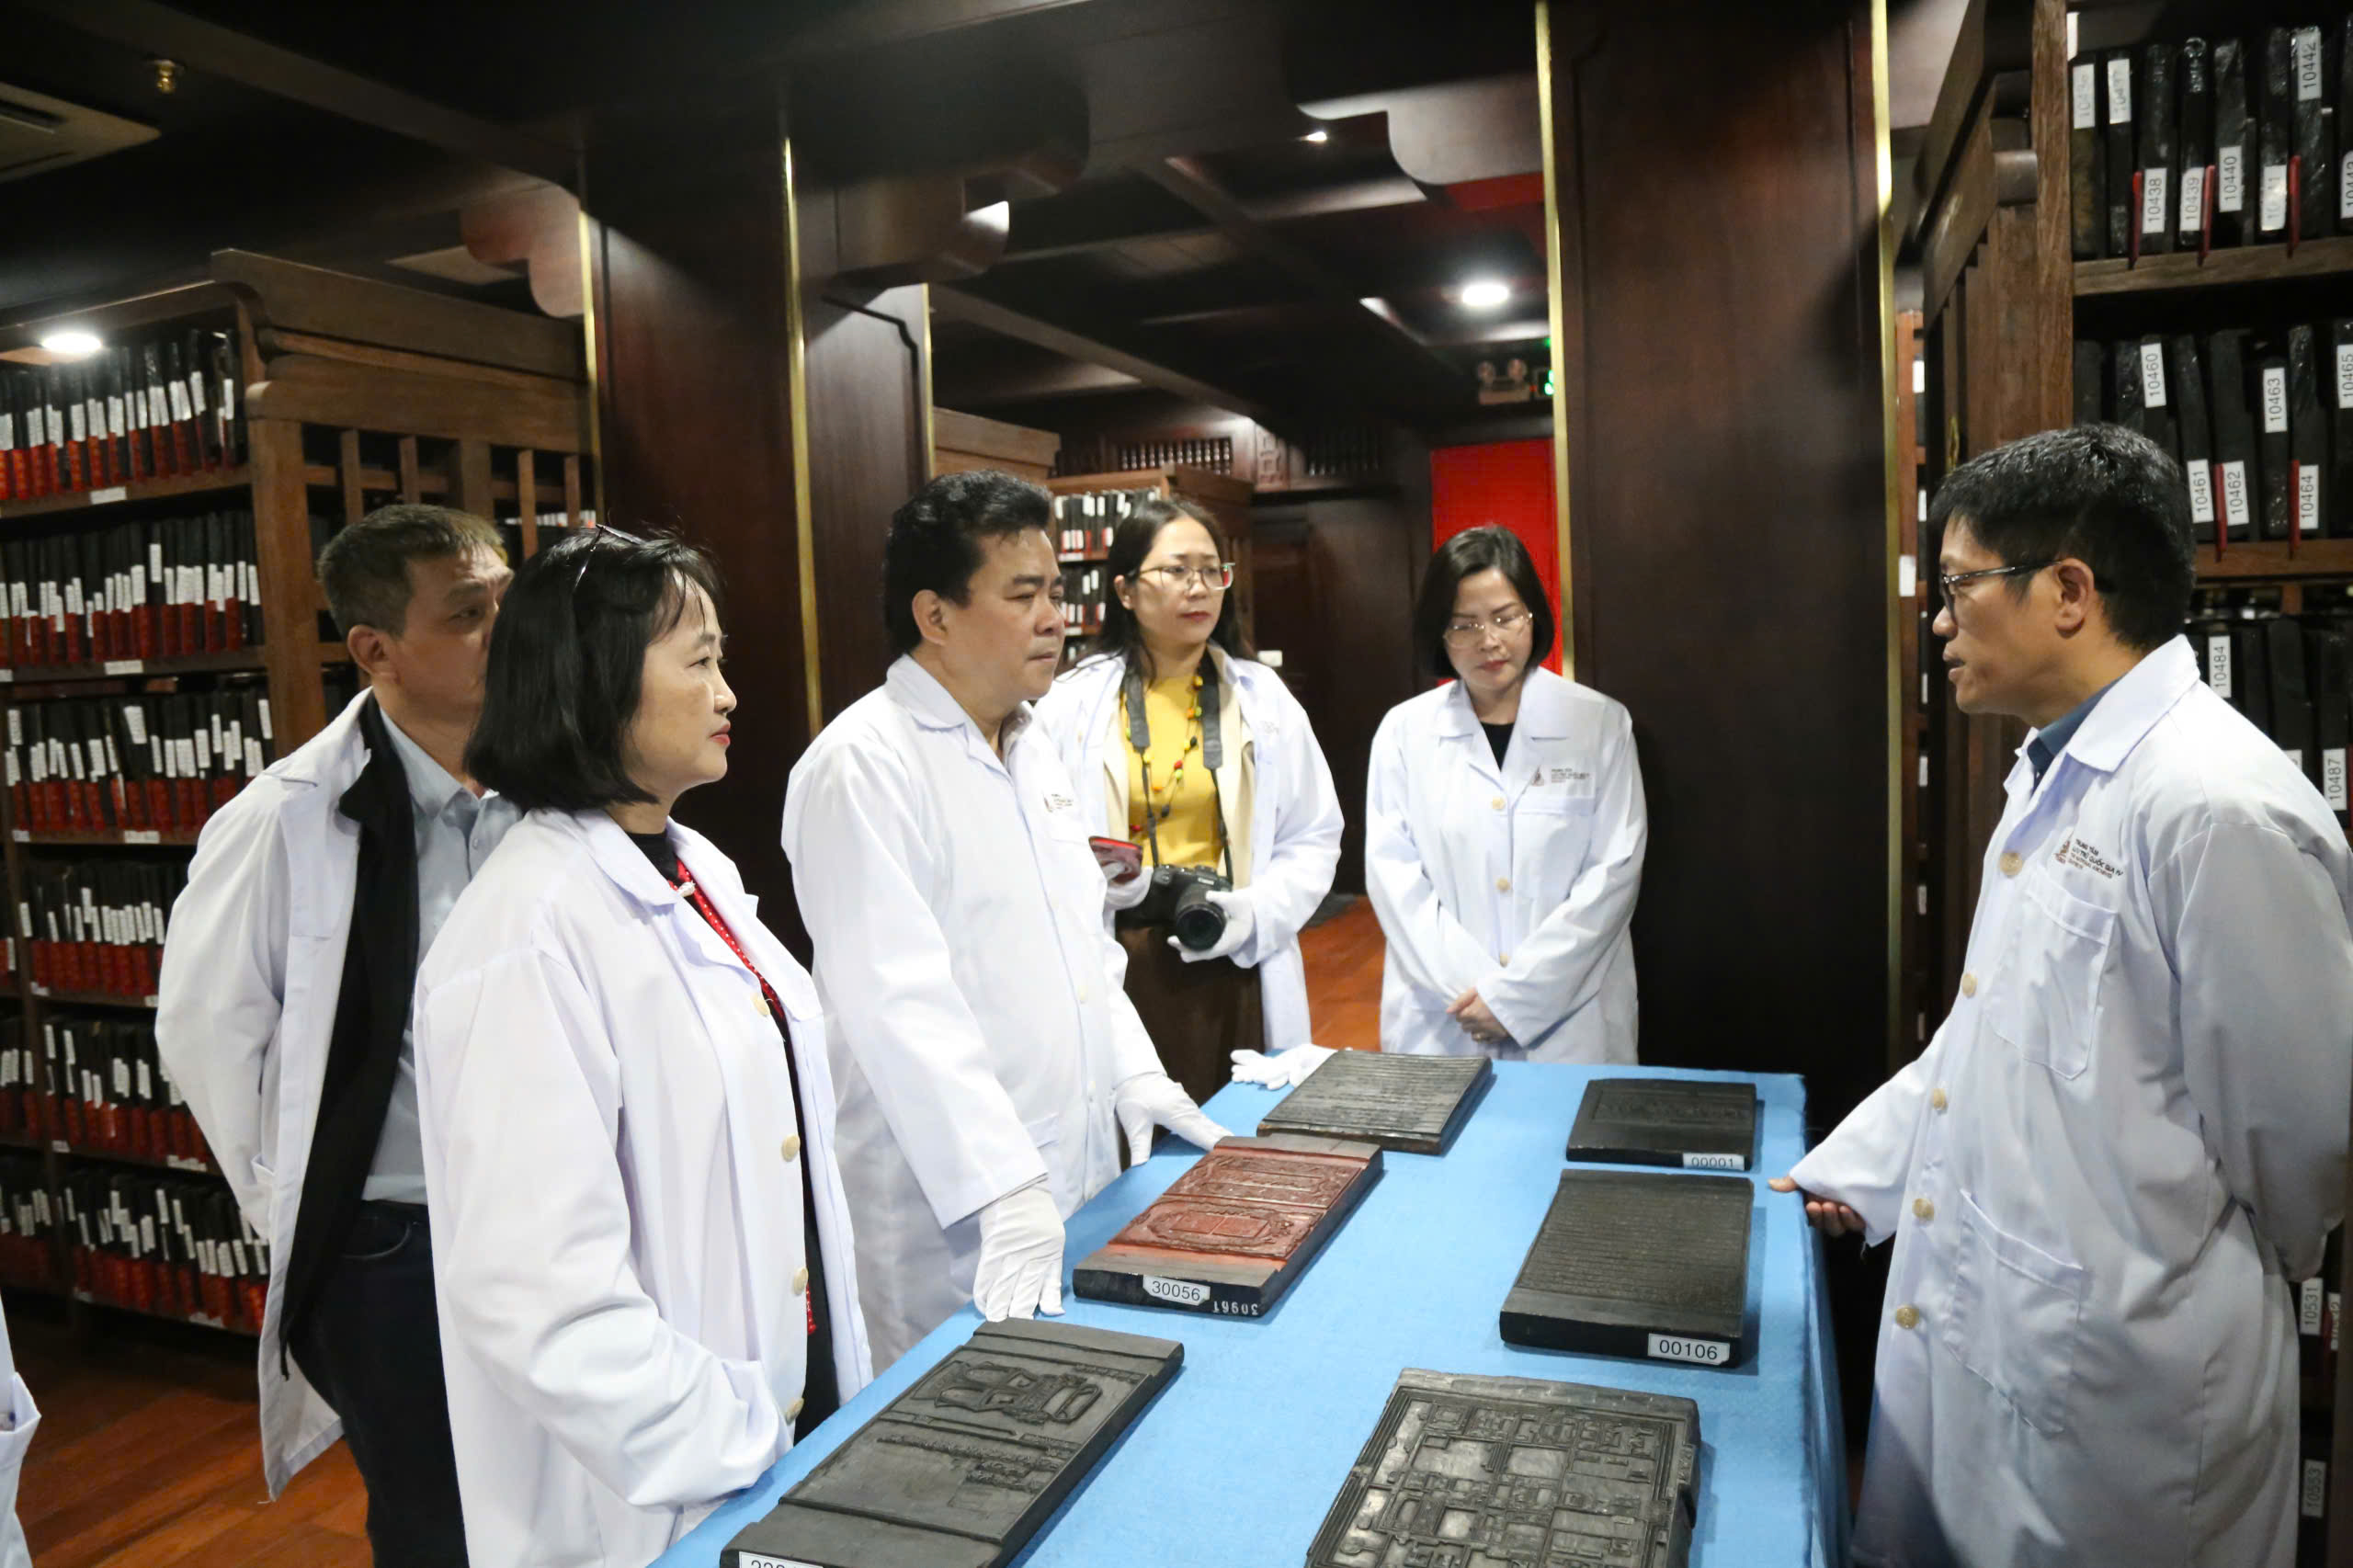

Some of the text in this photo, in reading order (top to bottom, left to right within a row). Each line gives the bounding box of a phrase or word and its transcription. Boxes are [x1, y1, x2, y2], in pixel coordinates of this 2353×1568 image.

[2302, 41, 2317, 90] 10442
[2147, 177, 2163, 223] 10438
[2186, 176, 2200, 221] 10439
[2223, 155, 2238, 202] 10440
[2266, 176, 2281, 220] 101
[2145, 352, 2161, 397] 10460
[2341, 354, 2353, 397] 10465
[2268, 377, 2282, 423] 10463
[2193, 470, 2209, 514] 10461
[2227, 471, 2243, 515] 10462
[2300, 474, 2313, 519] 10464
[2213, 645, 2227, 688] 10484
[2327, 758, 2342, 800] 10487
[1691, 1156, 1733, 1168] 00001
[1152, 1280, 1200, 1301] 30056
[2303, 1285, 2319, 1327] 10531
[1659, 1339, 1718, 1360] 00106
